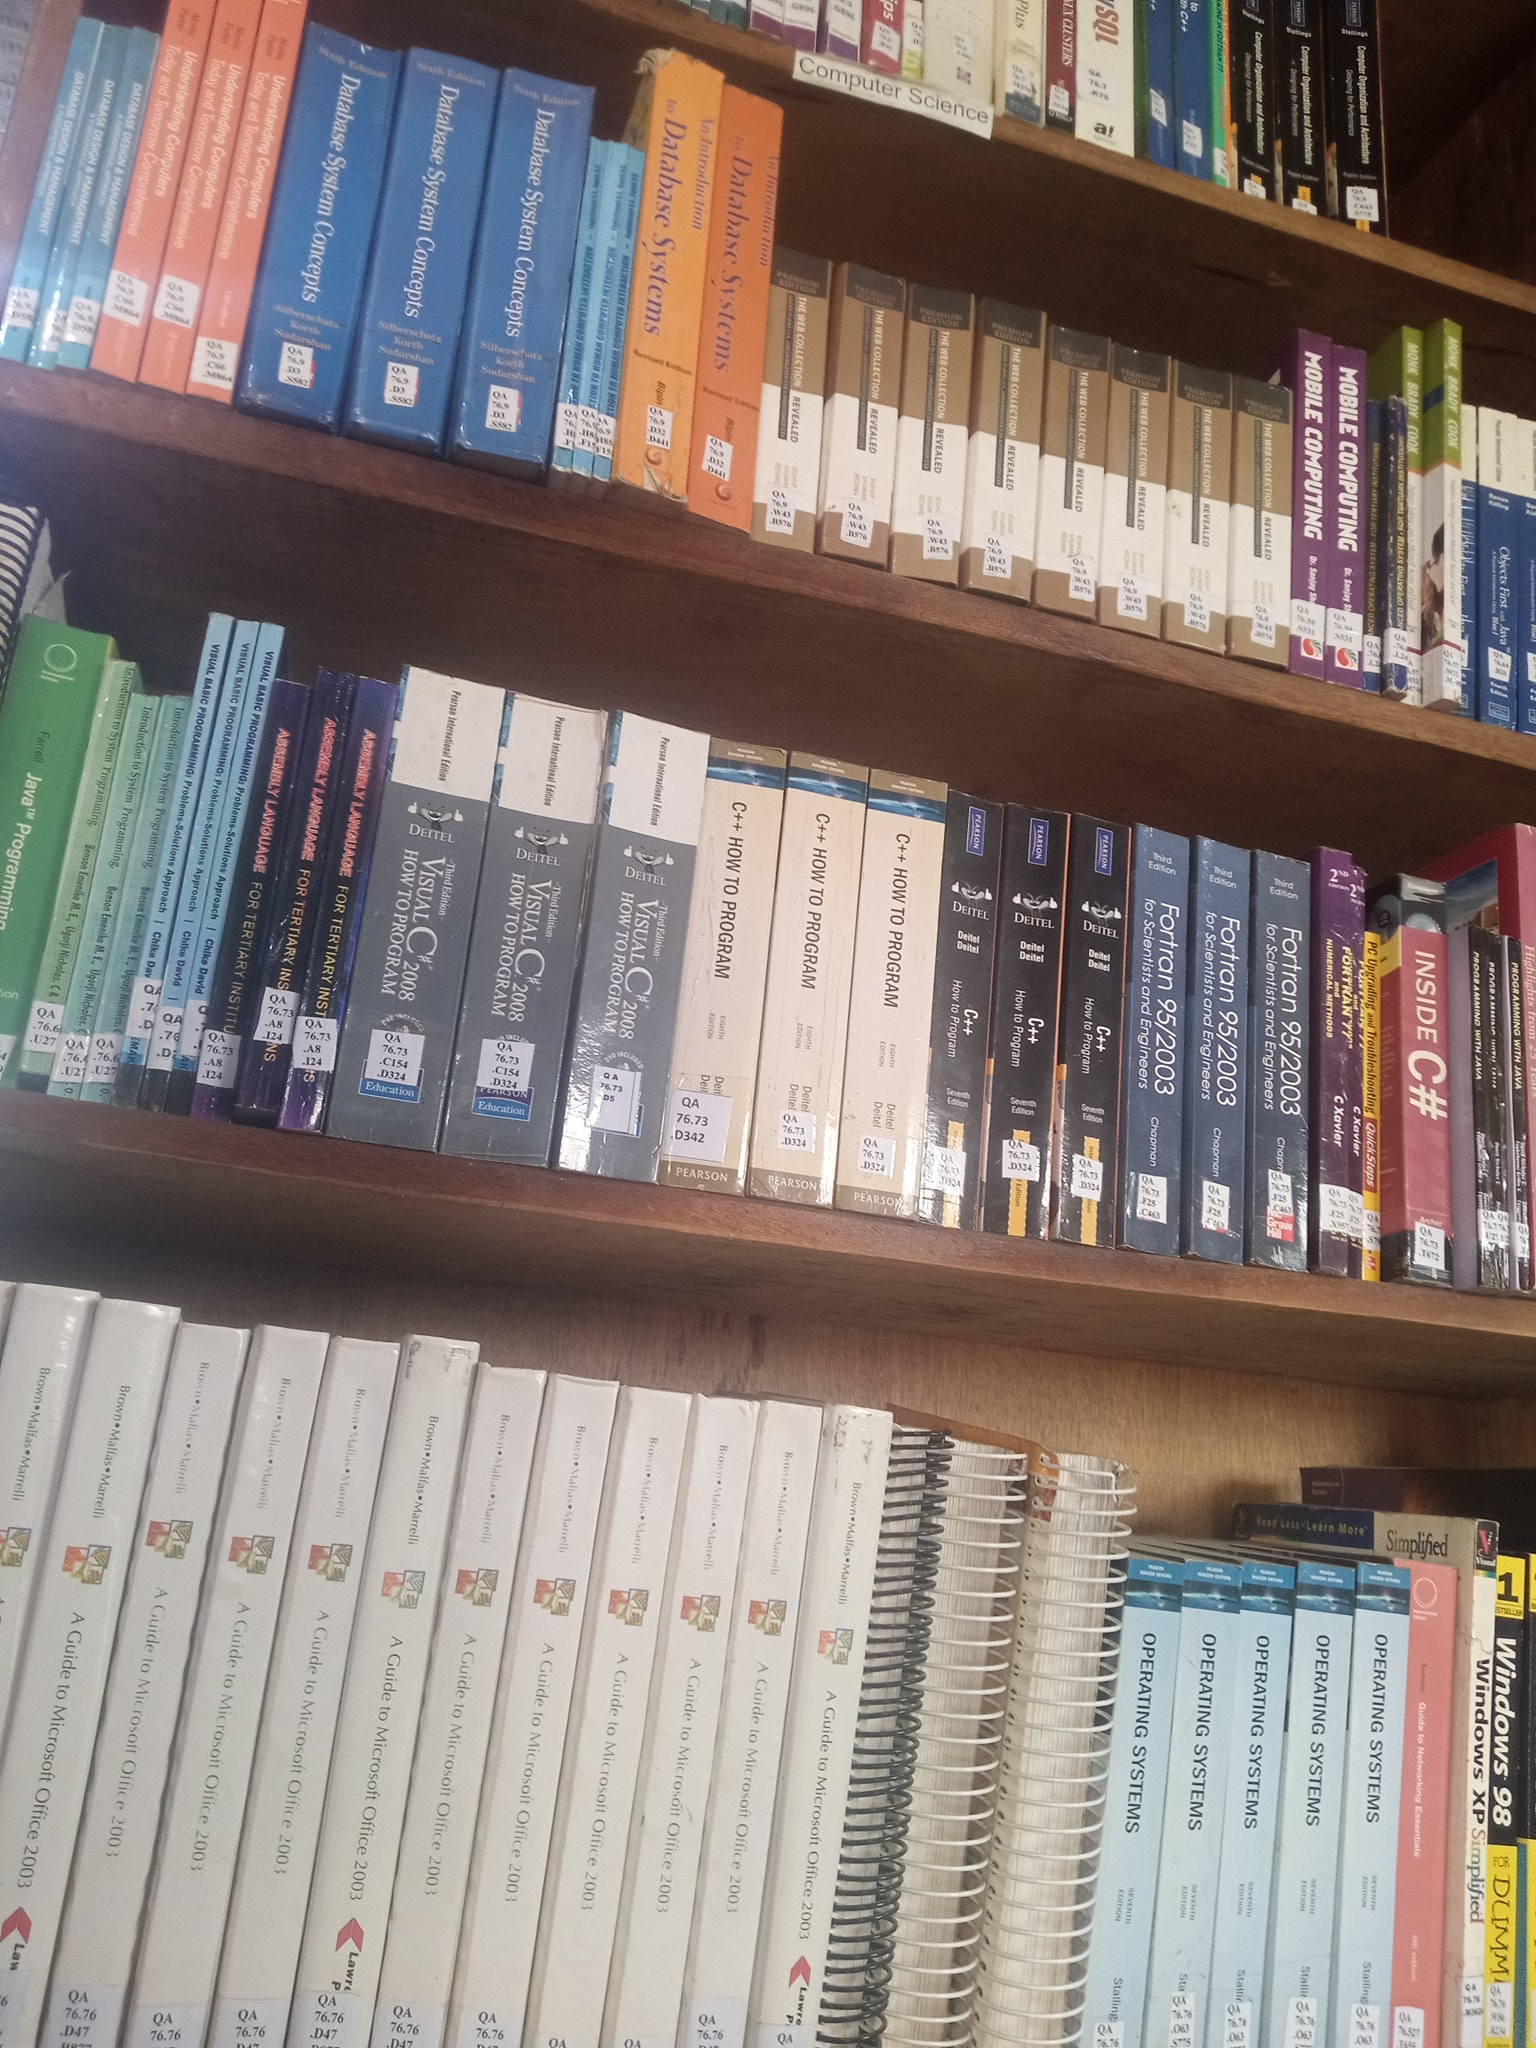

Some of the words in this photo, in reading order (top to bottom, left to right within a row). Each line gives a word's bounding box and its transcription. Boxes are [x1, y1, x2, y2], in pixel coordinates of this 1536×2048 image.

[1178, 10, 1188, 32] C++
[1340, 28, 1368, 38] Stallings
[1062, 18, 1073, 66] CLUSTERS
[1355, 45, 1367, 74] Computer
[166, 49, 198, 132] Understanding
[800, 56, 903, 99] Computer
[908, 87, 990, 124] Science
[1357, 75, 1369, 113] Organization
[327, 72, 362, 153] Database
[427, 82, 461, 166] Database
[1359, 115, 1370, 125] and
[525, 108, 556, 187] Database
[1360, 127, 1372, 164] Architecture
[153, 133, 180, 197] Computers
[652, 118, 688, 228] Database
[312, 152, 347, 217] System
[413, 167, 447, 232] System
[513, 187, 545, 253] System
[720, 156, 755, 265] Database
[297, 219, 334, 303] Concepts
[399, 235, 435, 319] Concepts
[501, 256, 535, 338] Concepts
[642, 231, 675, 336] Systems
[709, 267, 743, 372] Systems
[796, 317, 806, 332] WEB
[797, 297, 807, 316] THE
[391, 365, 407, 376] QA
[793, 334, 805, 385] COLLECTION
[1407, 343, 1418, 374] MONK
[1304, 351, 1323, 422] MOBILE
[1339, 366, 1358, 437] MOBILE
[1407, 383, 1418, 418] BRADY
[789, 396, 801, 442] REVEALED
[1407, 425, 1418, 453] COOK
[1005, 444, 1015, 490] REVEALED
[1303, 426, 1323, 540] COMPUTING
[770, 508, 791, 518] .W43
[772, 490, 786, 499] QA
[772, 499, 788, 508] 76.9
[1137, 485, 1145, 530] REVEALED
[1338, 440, 1358, 552] COMPUTING
[769, 518, 792, 528] .B576
[1498, 547, 1510, 584] Objects
[1498, 587, 1510, 608] First
[1498, 623, 1510, 644] Java
[259, 649, 275, 683] VISUAL
[253, 683, 268, 711] BASIC
[448, 689, 460, 715] Pearson
[132, 706, 152, 760] Introduction
[238, 713, 262, 785] PROGRAMMING:
[441, 717, 456, 758] International
[130, 760, 141, 770] to
[266, 727, 291, 797] ASSEMBLY
[438, 759, 450, 782] Edition
[122, 771, 139, 804] System
[409, 823, 454, 844] DEITEL
[729, 801, 747, 832] C++
[252, 799, 278, 874] LANGUAGE
[725, 836, 743, 872] HOW
[893, 832, 911, 862] C++
[1035, 825, 1044, 860] PEARSON
[397, 848, 419, 886] HOW
[1148, 860, 1177, 876] Edition
[1152, 852, 1173, 865] Third
[208, 874, 228, 920] Approach
[247, 880, 261, 909] FOR
[393, 886, 413, 912] TO
[411, 853, 445, 926] VISUAL
[723, 876, 739, 896] TO
[890, 867, 909, 904] HOW
[889, 907, 906, 925] TO
[1014, 911, 1055, 929] DEITEL
[1143, 898, 1155, 916] for
[233, 913, 256, 977] TERTIARY
[380, 913, 409, 995] PROGRAM
[714, 900, 737, 980] PROGRAM
[1019, 951, 1044, 963] Deitel
[1020, 940, 1045, 952] Deitel
[1141, 919, 1154, 983] Scientists
[1157, 903, 1179, 990] Fortran
[1367, 942, 1377, 954] PC
[397, 961, 420, 1002] 2008
[883, 930, 904, 1008] PROGRAM
[1364, 959, 1377, 1011] Upgrading
[1014, 990, 1025, 1011] How
[1140, 986, 1152, 1015] and
[1414, 950, 1437, 1043] INSIDE
[1472, 951, 1481, 1026] PROGRAMMING
[37, 1007, 55, 1020] QA
[1013, 1013, 1023, 1022] to
[1027, 1017, 1045, 1044] C++
[30, 1034, 56, 1047] .U27
[207, 1044, 233, 1056] 76.73
[208, 1032, 226, 1043] QA
[382, 1045, 408, 1057] 76.73
[384, 1033, 401, 1043] QA
[1008, 1025, 1023, 1067] Program
[1136, 1018, 1151, 1089] Engineers
[1152, 998, 1176, 1094] 95/2003
[204, 1057, 222, 1067] .A8
[377, 1070, 406, 1082] .D324
[379, 1058, 409, 1070] .C154
[1365, 1032, 1377, 1114] Troubleshooting
[1474, 1056, 1482, 1080] JAVA
[365, 1082, 416, 1098] Education
[682, 1097, 700, 1108] QA
[1407, 1049, 1448, 1120] C#
[670, 1129, 705, 1143] .D342
[676, 1113, 709, 1127] 76.73
[1332, 1106, 1344, 1147] Xavier
[1149, 1116, 1159, 1167] Chapman
[1365, 1123, 1376, 1186] QuickSteps
[675, 1166, 728, 1182] PEARSON
[1386, 1529, 1449, 1560] Simplified
[1497, 1572, 1519, 1603] 1
[69, 1611, 86, 1625] A
[58, 1628, 82, 1680] Guide
[55, 1683, 72, 1701] to
[1133, 1631, 1156, 1738] OPERATING
[1370, 1634, 1387, 1732] OPERATING
[1416, 1703, 1426, 1731] Guide
[1472, 1659, 1489, 1780] Windows
[1493, 1639, 1516, 1776] Windows
[38, 1705, 67, 1783] Microsoft
[1416, 1734, 1425, 1743] to
[1124, 1744, 1146, 1833] SYSTEMS
[1366, 1739, 1382, 1823] SYSTEMS
[1414, 1746, 1425, 1803] Networking
[25, 1786, 52, 1841] Office
[1471, 1789, 1486, 1824] XP
[1492, 1786, 1511, 1826] 98
[1413, 1805, 1423, 1856] Essentials
[16, 1844, 39, 1890] 2003
[1465, 1827, 1484, 1923] Simplified
[65, 2007, 96, 2021] 76.76
[69, 1990, 88, 2004] QA
[60, 2025, 89, 2037] .D47
